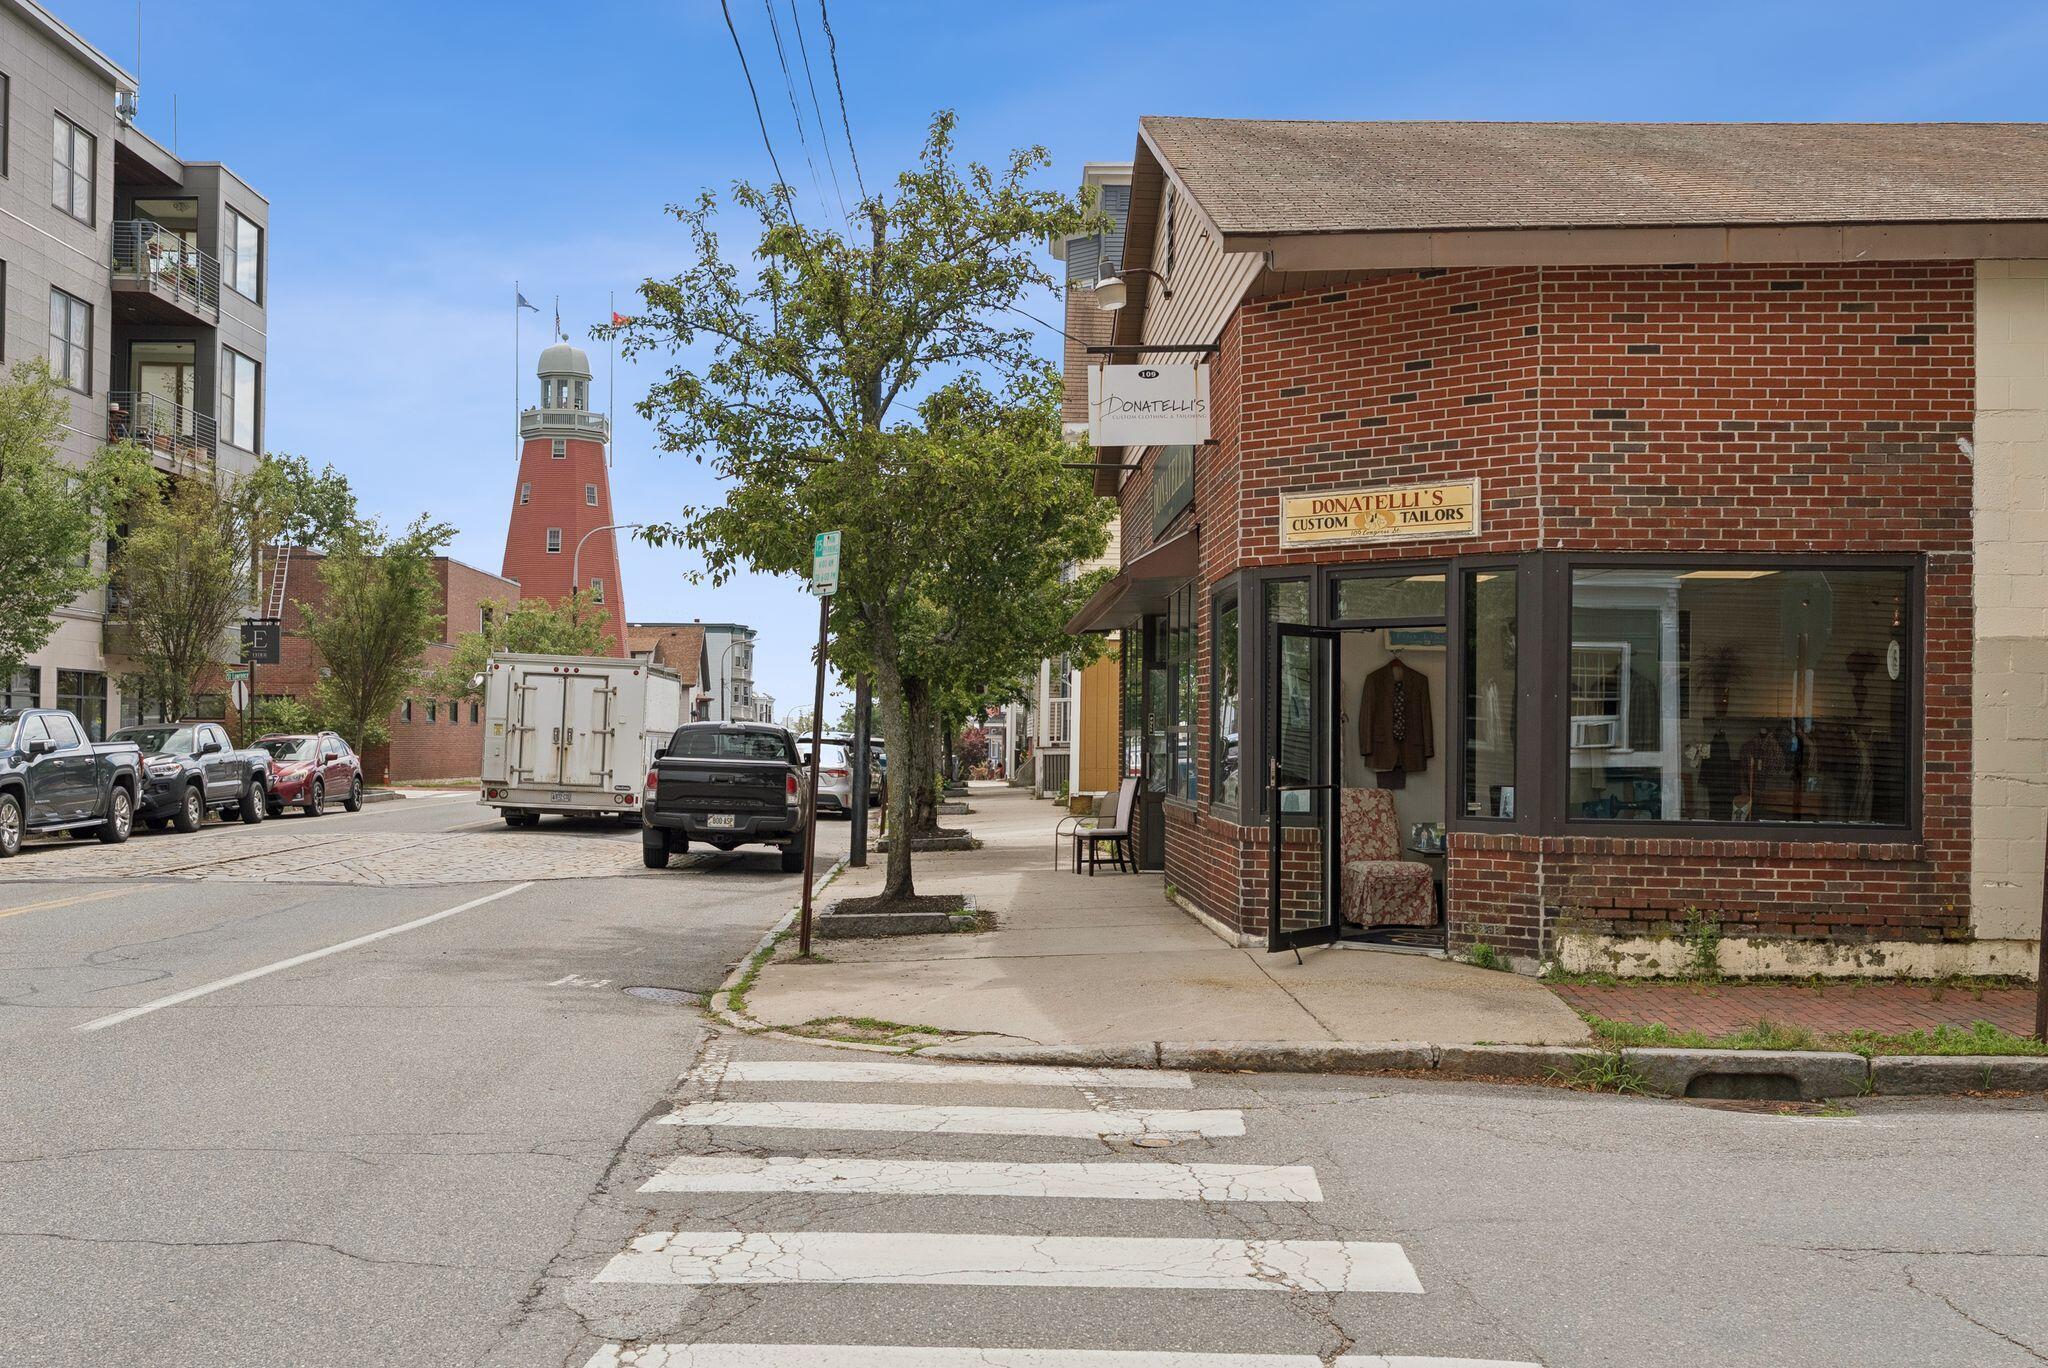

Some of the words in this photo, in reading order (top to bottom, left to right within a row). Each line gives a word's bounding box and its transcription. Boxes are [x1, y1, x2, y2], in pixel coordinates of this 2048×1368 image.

[1312, 489, 1444, 515] DONATELLI'S
[1292, 516, 1348, 531] CUSTOM
[1400, 507, 1464, 523] TAILORS
[254, 630, 267, 649] E
